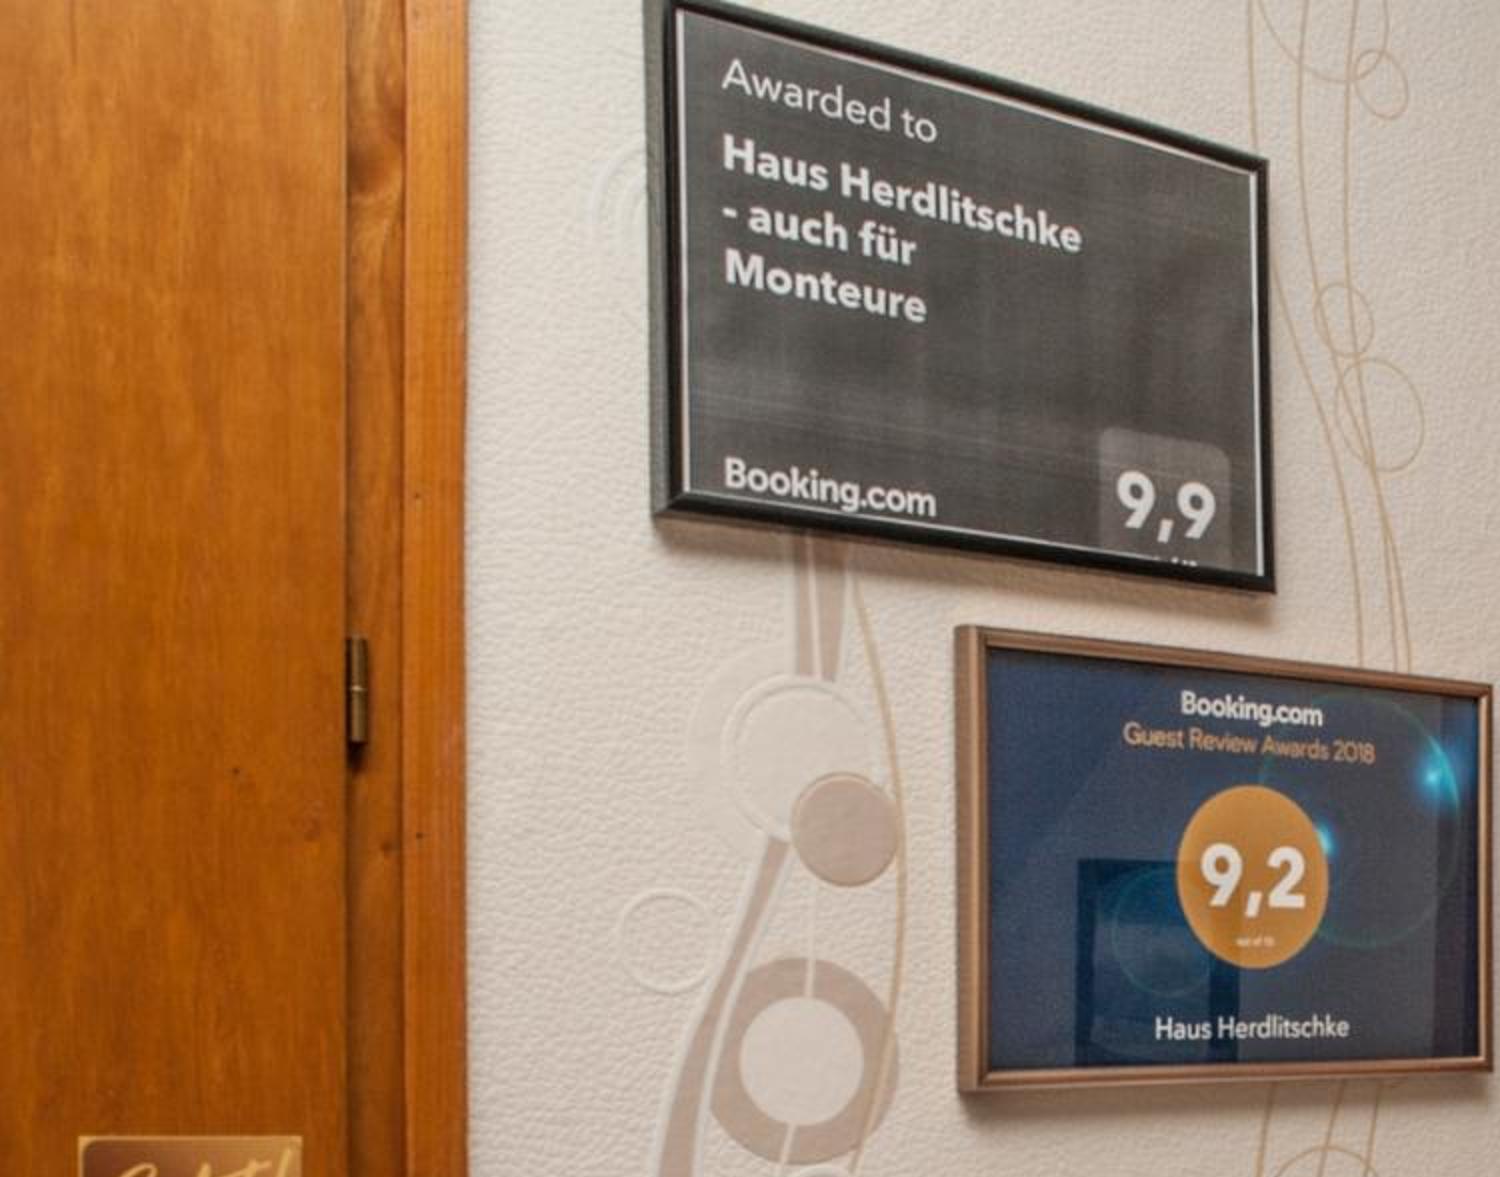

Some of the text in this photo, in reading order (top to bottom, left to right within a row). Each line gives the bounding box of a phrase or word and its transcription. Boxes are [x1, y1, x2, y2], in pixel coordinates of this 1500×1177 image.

[722, 58, 938, 144] Awarded to
[723, 134, 1083, 253] Haus Herdlitschke
[748, 205, 847, 252] auch
[859, 221, 917, 267] für
[725, 249, 927, 322] Monteure
[724, 458, 937, 517] Booking.com
[1116, 471, 1216, 543] 9,9
[1181, 691, 1323, 726] Booking.com
[1123, 722, 1376, 765] Guest Review Awards 2018
[1201, 842, 1307, 918] 9,2
[1155, 1013, 1351, 1041] Haus Herdlitschke
